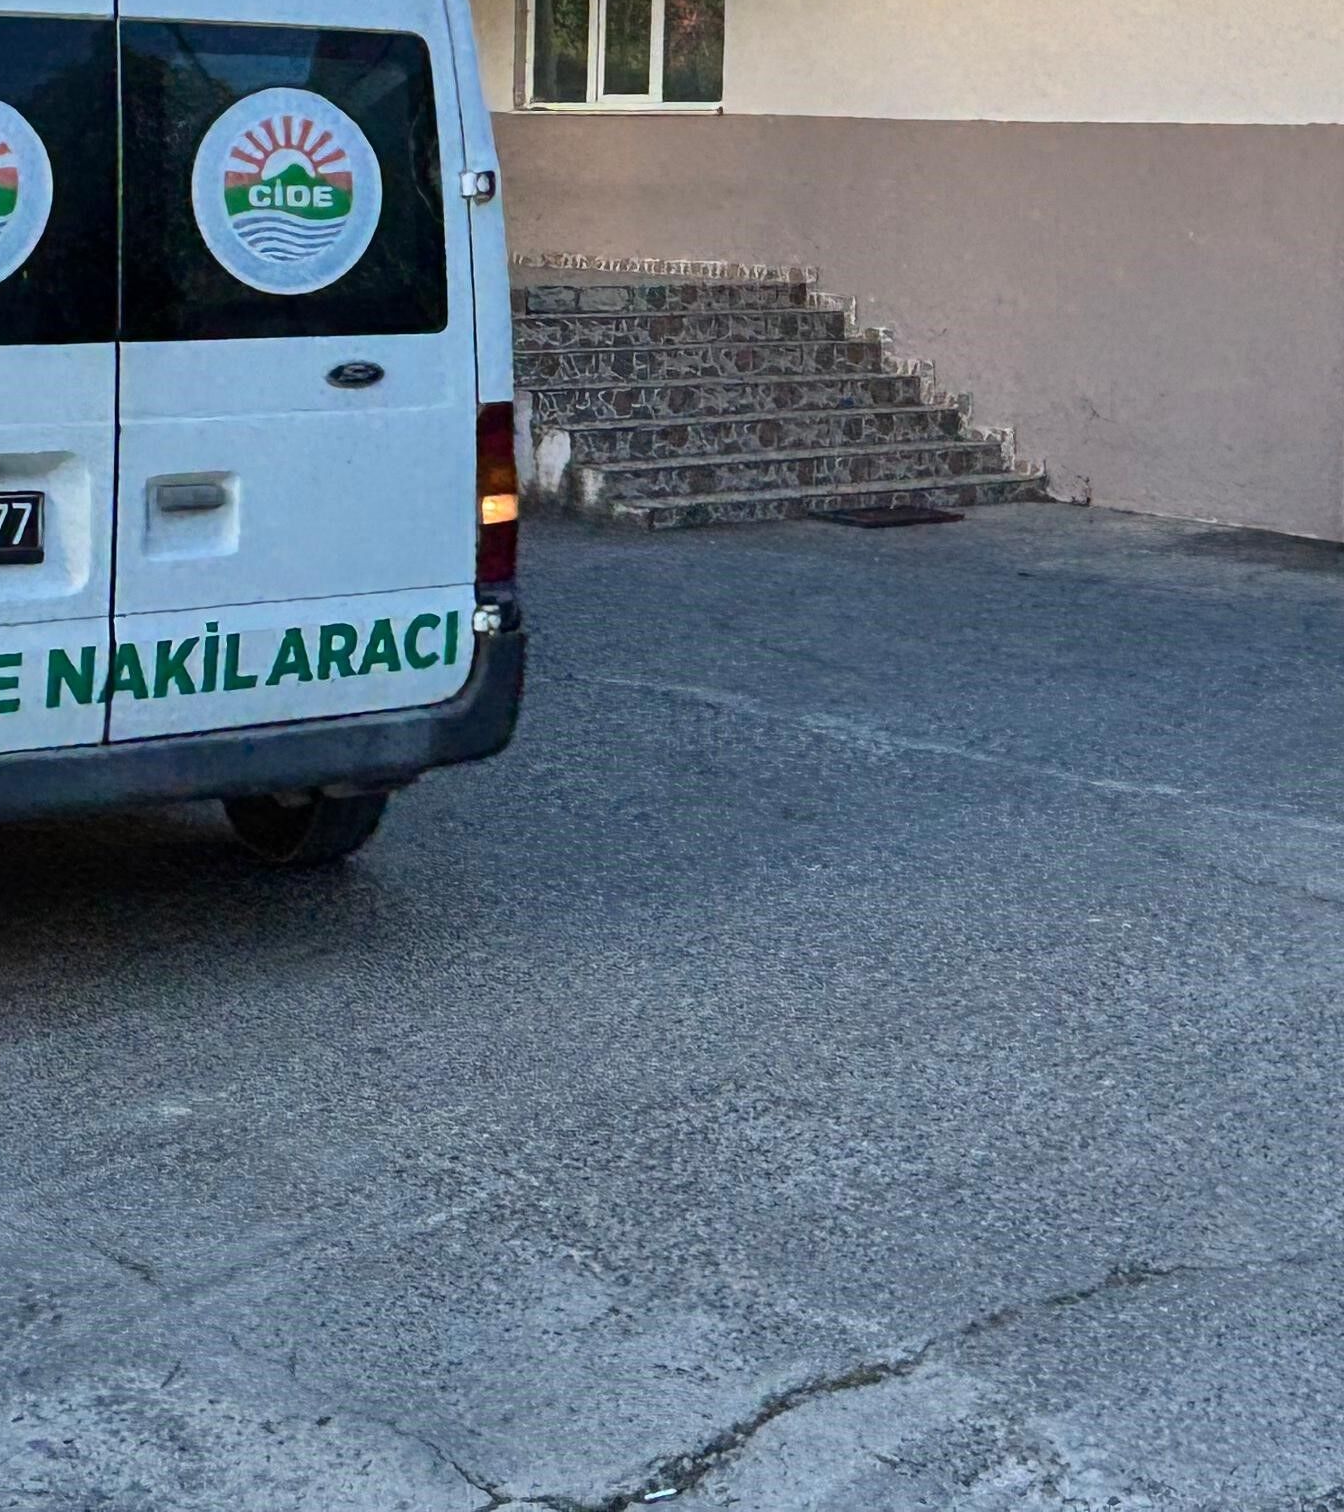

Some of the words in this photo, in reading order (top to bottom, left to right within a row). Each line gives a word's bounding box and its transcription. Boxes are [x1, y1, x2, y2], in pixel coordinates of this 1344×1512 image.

[248, 178, 335, 208] CİDE
[46, 620, 258, 709] NAKİL
[266, 608, 459, 687] ARACI
